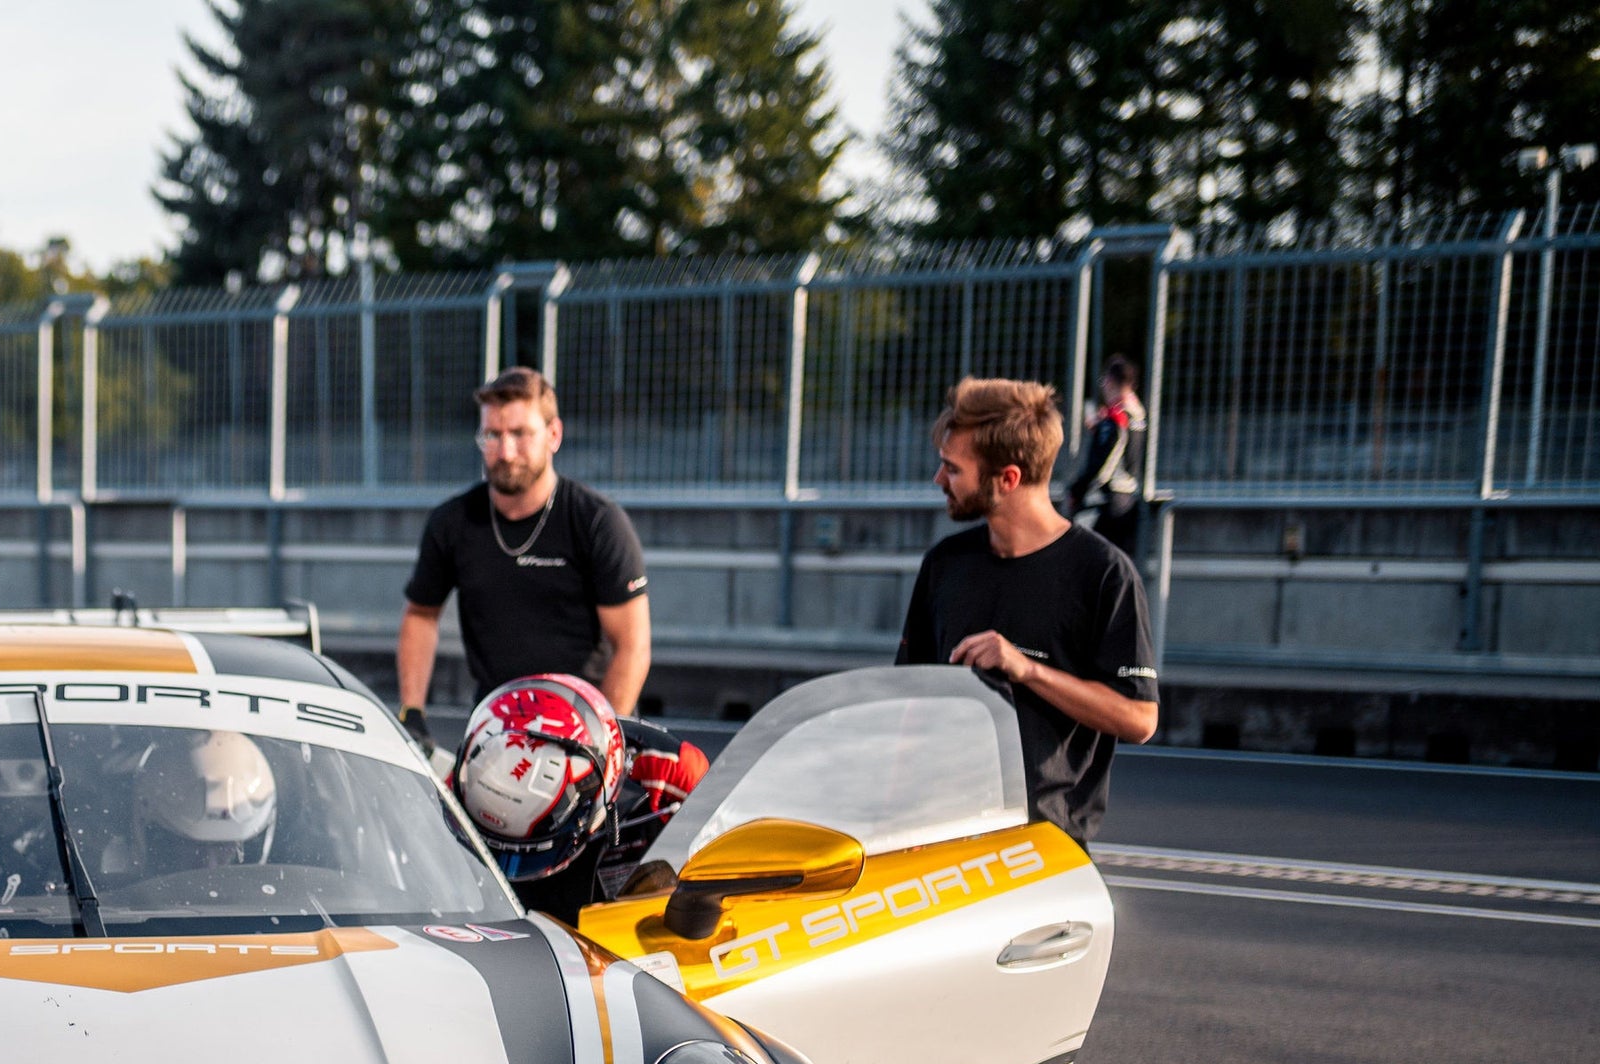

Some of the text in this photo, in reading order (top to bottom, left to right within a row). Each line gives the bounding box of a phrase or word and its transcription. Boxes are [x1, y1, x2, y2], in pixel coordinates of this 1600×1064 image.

[709, 840, 1045, 980] GT SPORTS
[9, 943, 319, 956] SPORTS
